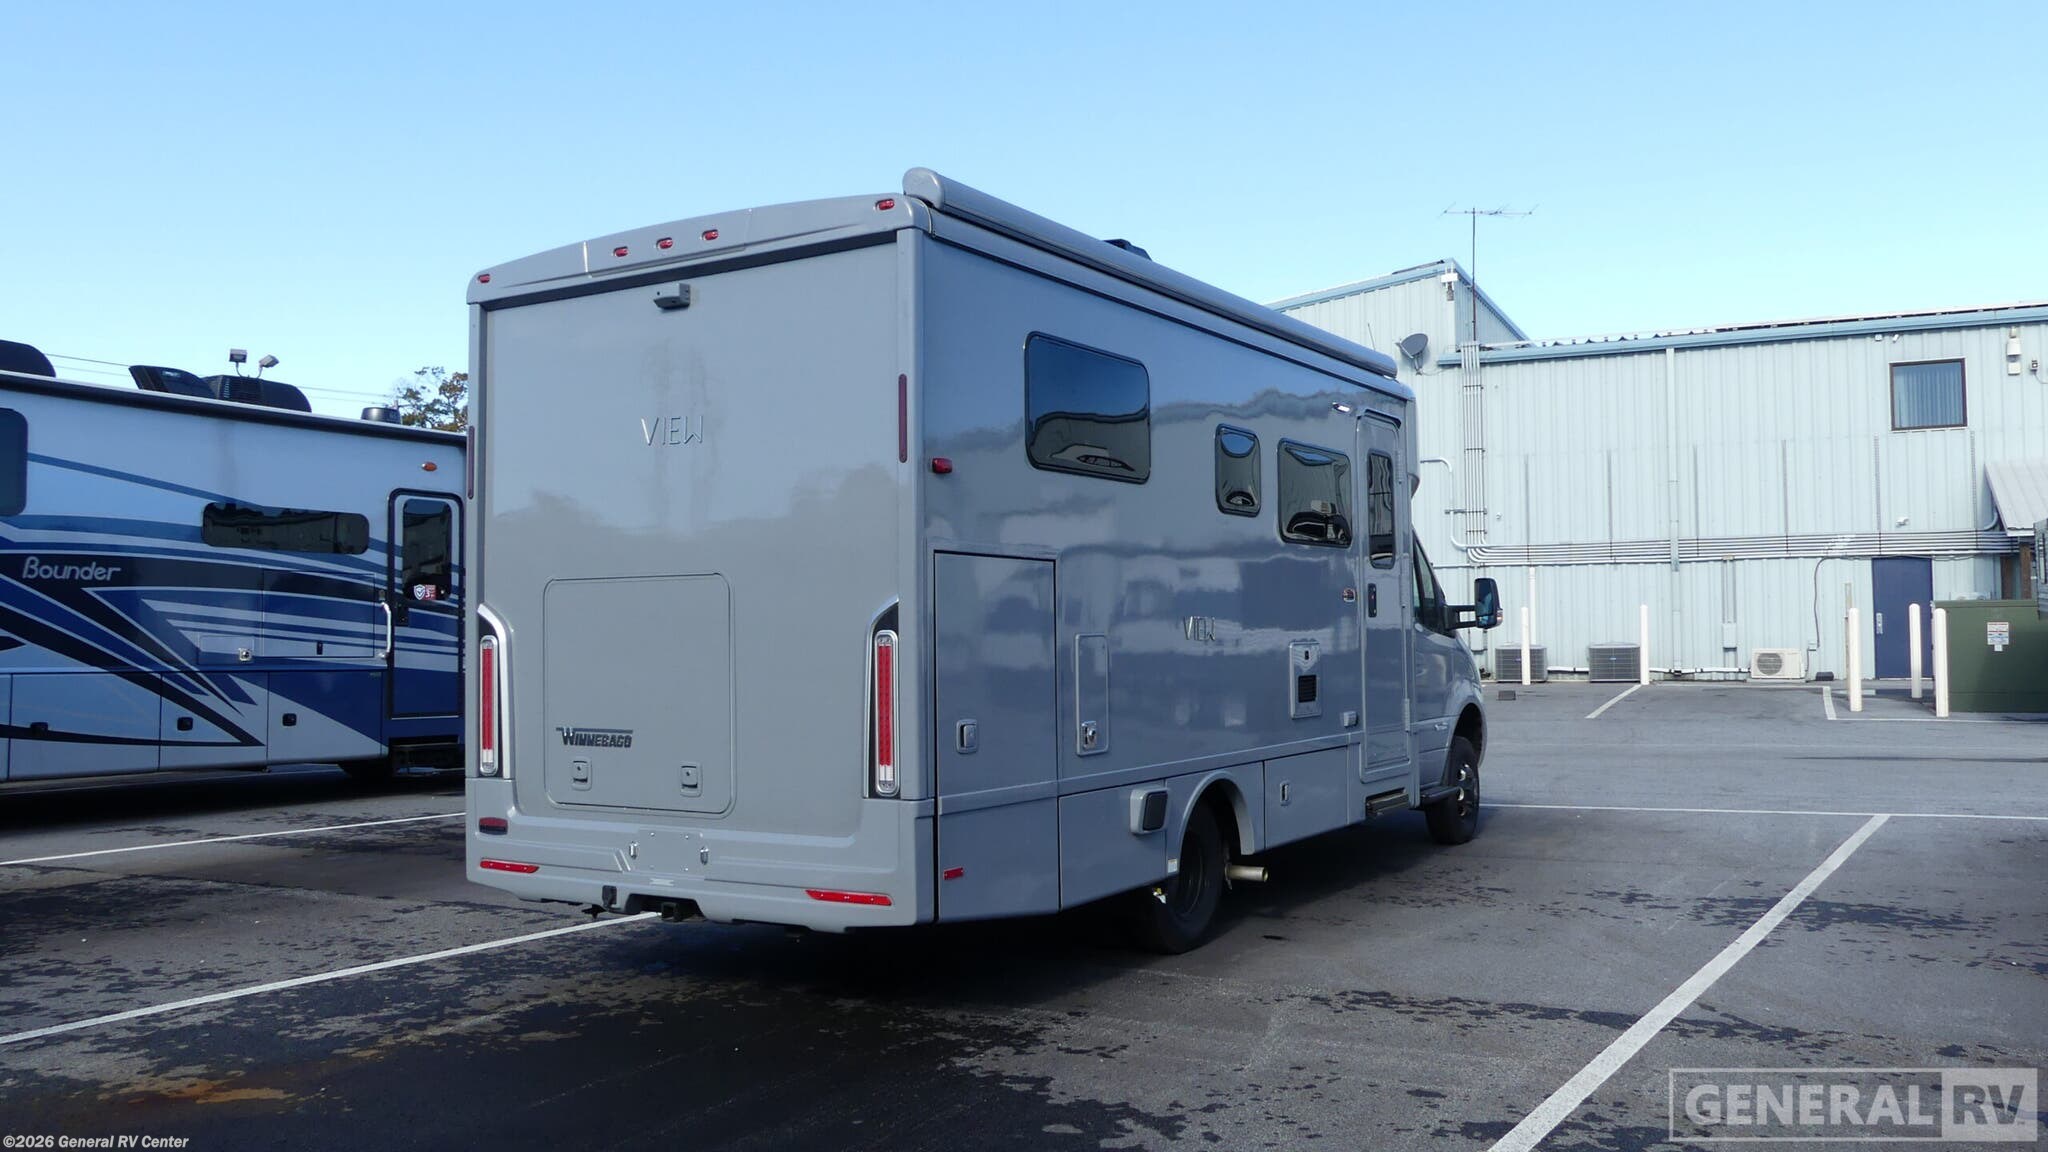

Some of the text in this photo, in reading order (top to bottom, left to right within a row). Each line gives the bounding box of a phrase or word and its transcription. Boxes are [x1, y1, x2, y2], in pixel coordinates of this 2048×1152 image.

[640, 414, 704, 446] VIEW
[22, 556, 122, 581] Bounder
[557, 727, 633, 748] WINNEBAGO
